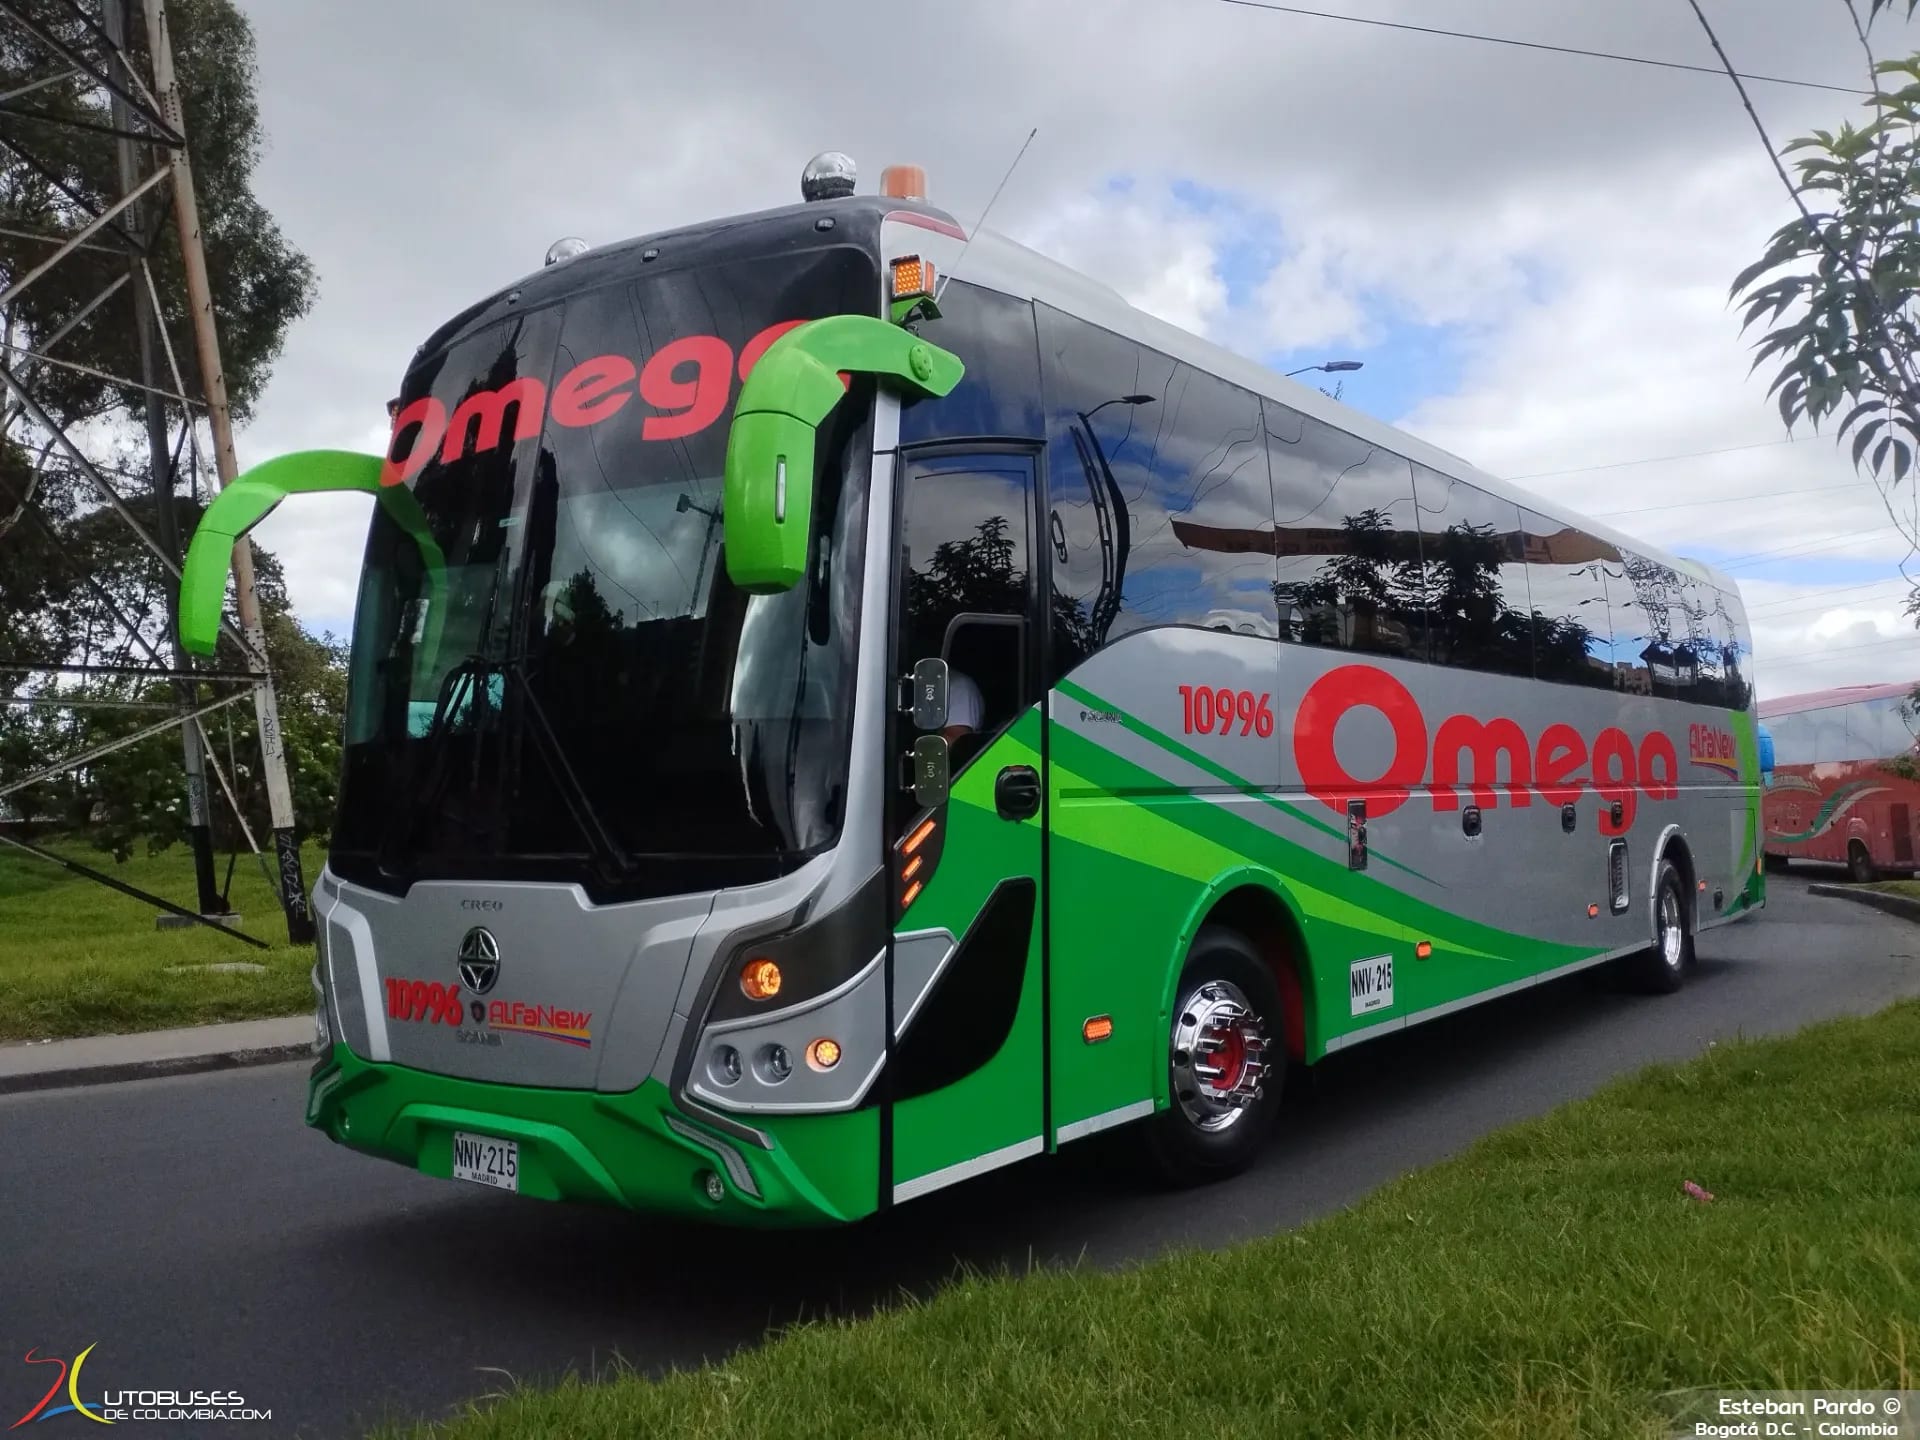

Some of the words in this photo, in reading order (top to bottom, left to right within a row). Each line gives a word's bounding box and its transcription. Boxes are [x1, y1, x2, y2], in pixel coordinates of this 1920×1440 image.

[1178, 684, 1274, 738] 10996
[1293, 664, 1679, 837] Omega
[384, 976, 463, 1027] 10996
[471, 1171, 498, 1185] MADRID
